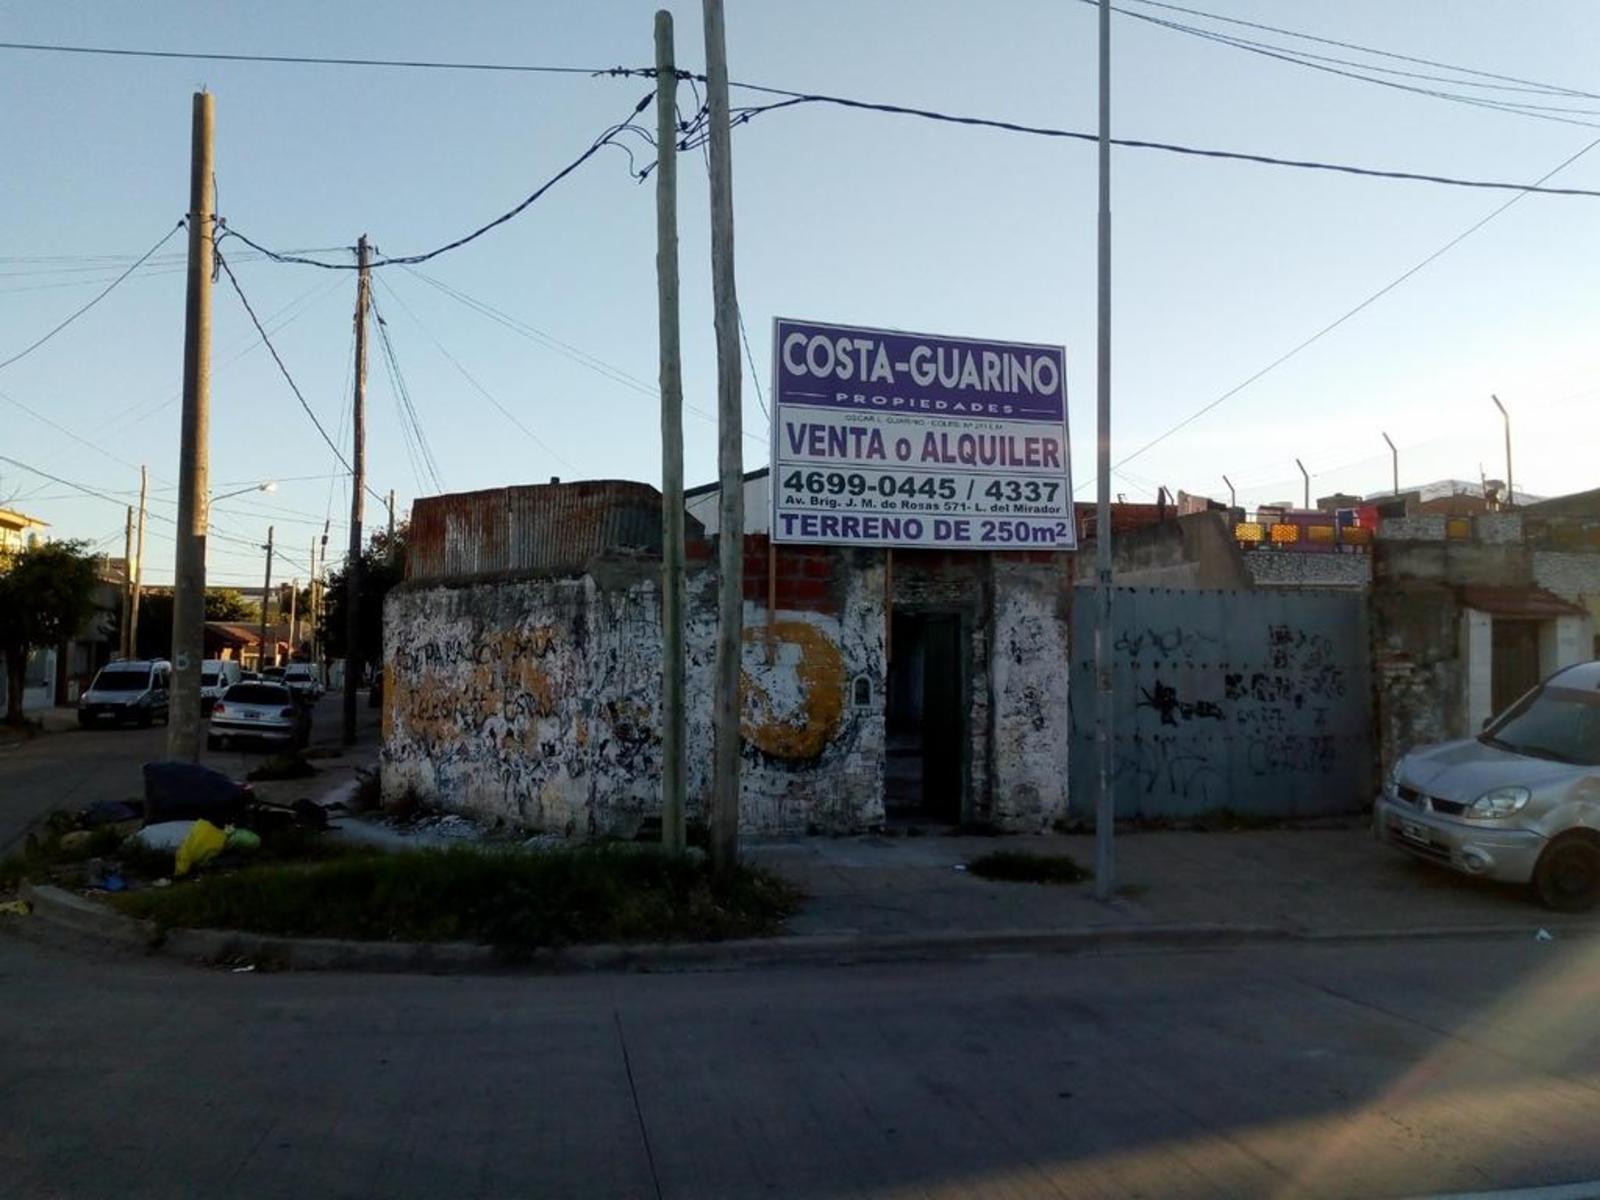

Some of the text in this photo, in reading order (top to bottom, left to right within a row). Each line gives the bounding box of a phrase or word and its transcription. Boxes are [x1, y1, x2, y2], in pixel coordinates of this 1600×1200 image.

[783, 332, 1059, 395] COSTA-GUARINO
[836, 393, 1013, 414] PROPIEDADES
[786, 422, 1060, 468] VENTA o ALQUILER
[784, 471, 956, 499] 4699-0445
[985, 480, 1059, 502] 4337
[785, 495, 805, 505] Av.
[810, 496, 841, 508] Brig.
[846, 498, 857, 507] J.
[862, 499, 877, 508] M.
[881, 500, 897, 509] de
[901, 501, 939, 510] Rosas
[975, 503, 986, 512] L.
[990, 503, 1010, 512] del
[1014, 504, 1060, 513] Mirador
[780, 514, 923, 539] TERRENO
[934, 520, 971, 541] DE
